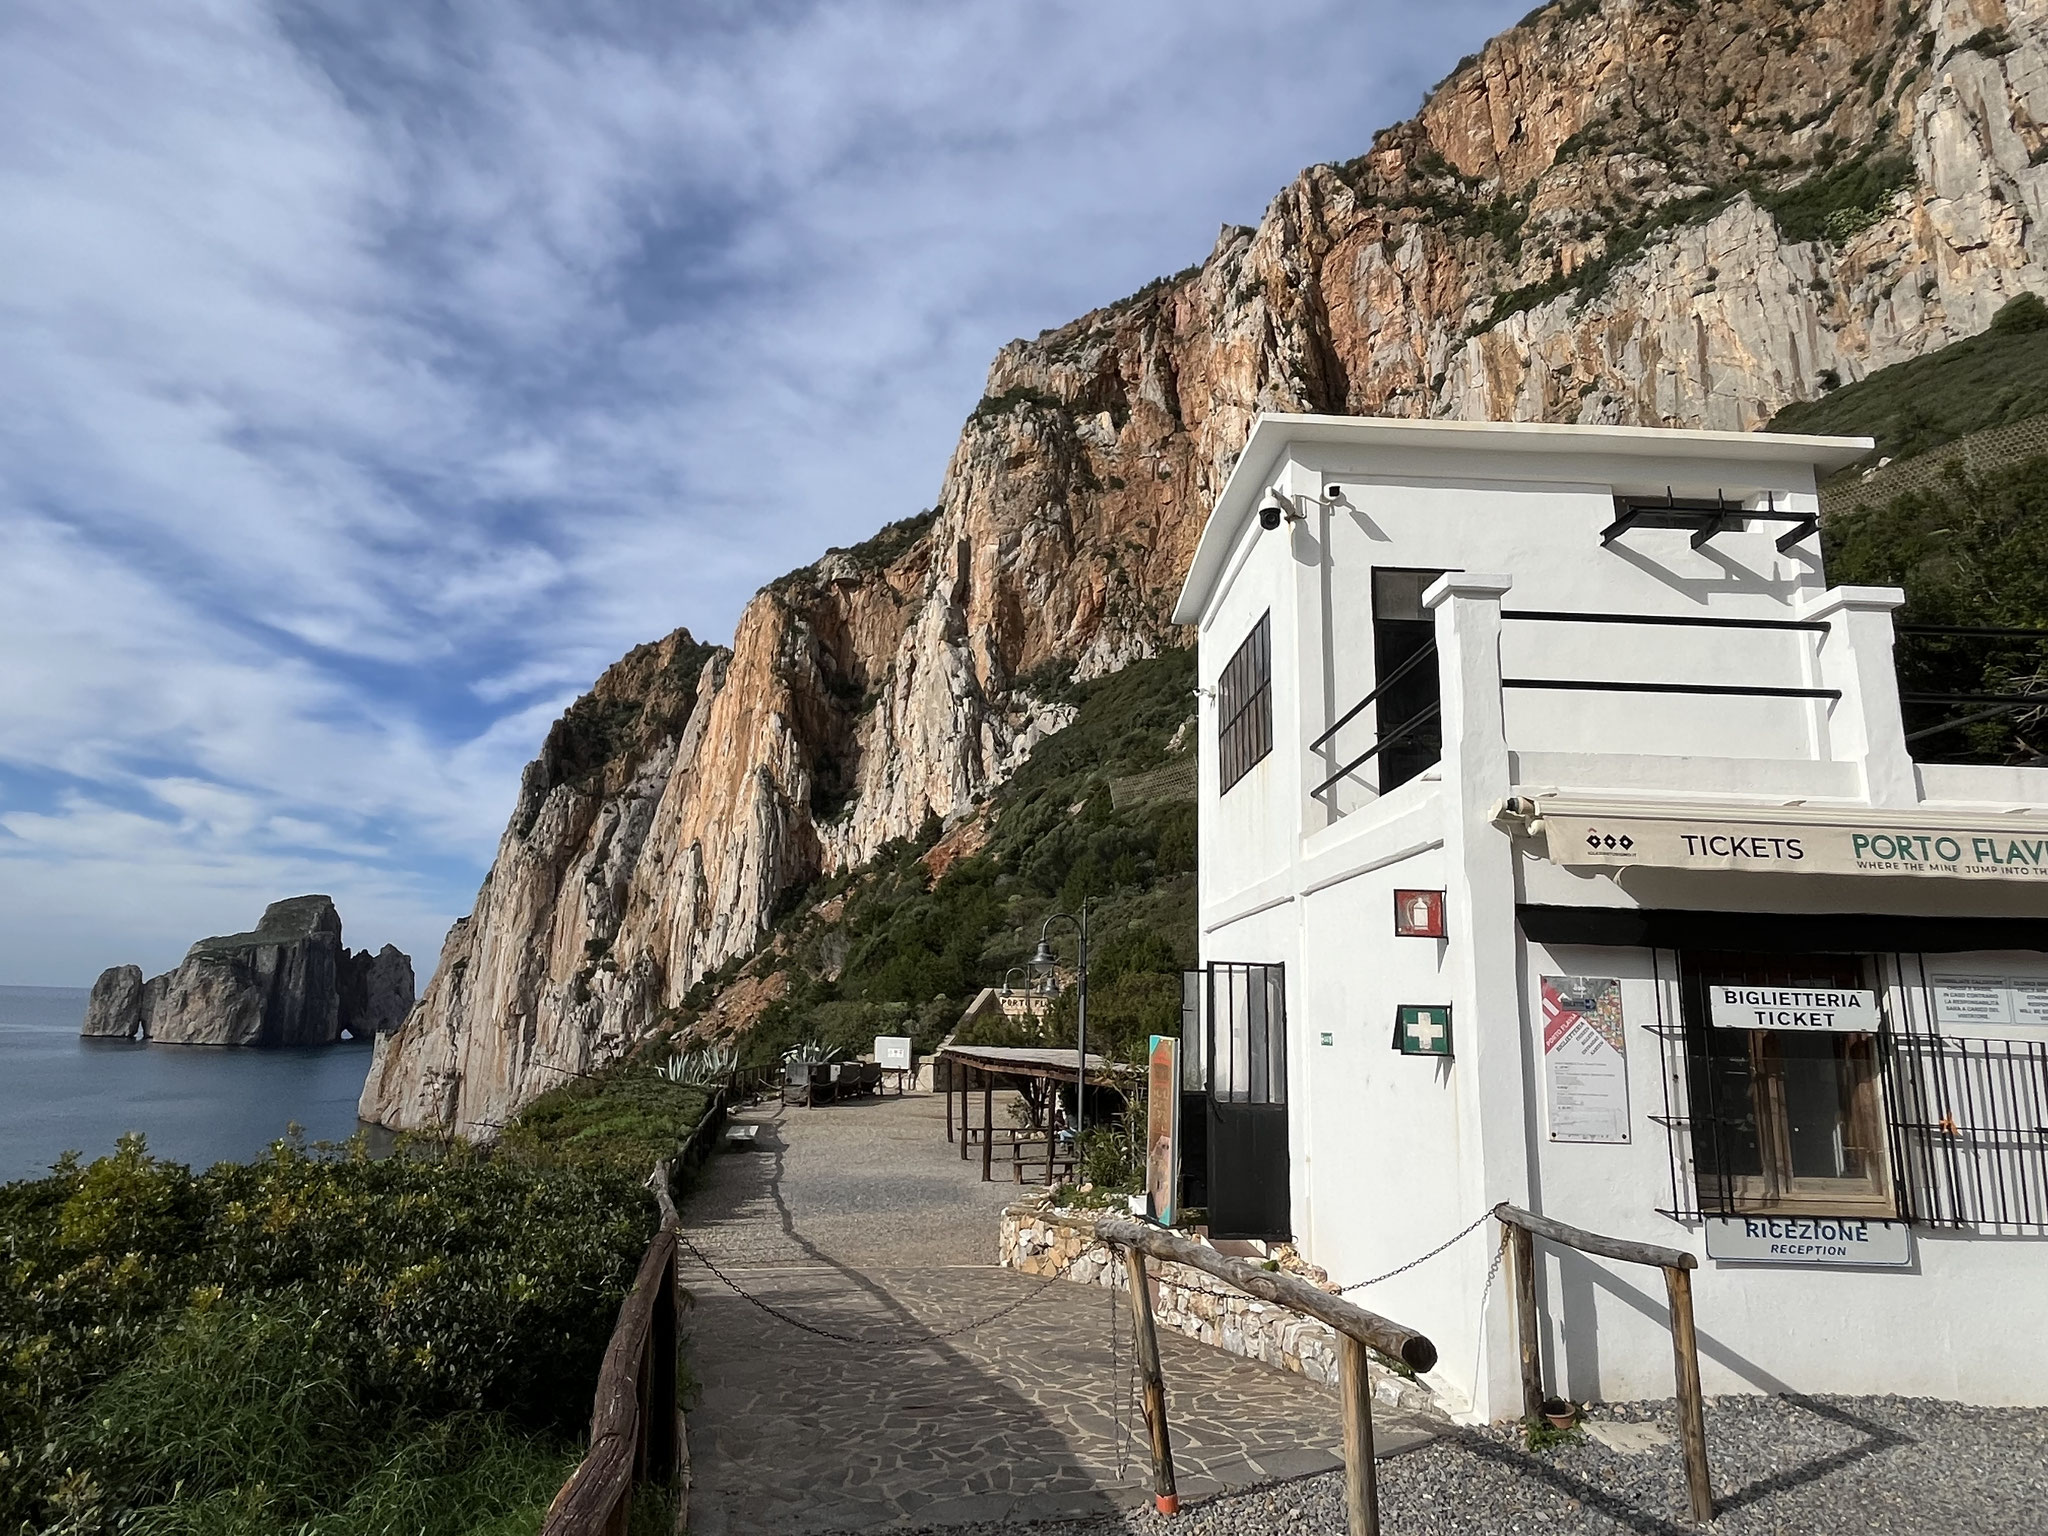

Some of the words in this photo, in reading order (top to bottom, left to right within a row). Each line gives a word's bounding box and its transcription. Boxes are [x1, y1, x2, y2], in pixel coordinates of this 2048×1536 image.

[1680, 834, 1804, 860] TICKETS
[1852, 833, 1961, 862] PORTO
[1856, 861, 1899, 870] WHERE
[1903, 862, 1925, 871] THE
[1929, 864, 1958, 873] MINE
[1965, 865, 1998, 874] JUMP
[2001, 867, 2029, 875] INTO
[1724, 990, 1861, 1008] BIGLIETTERIA
[1754, 1011, 1835, 1027] TICKET
[1546, 1028, 1563, 1047] PORTO
[1746, 1221, 1869, 1242] RICEZIONE
[1771, 1244, 1847, 1256] RECEPTION
